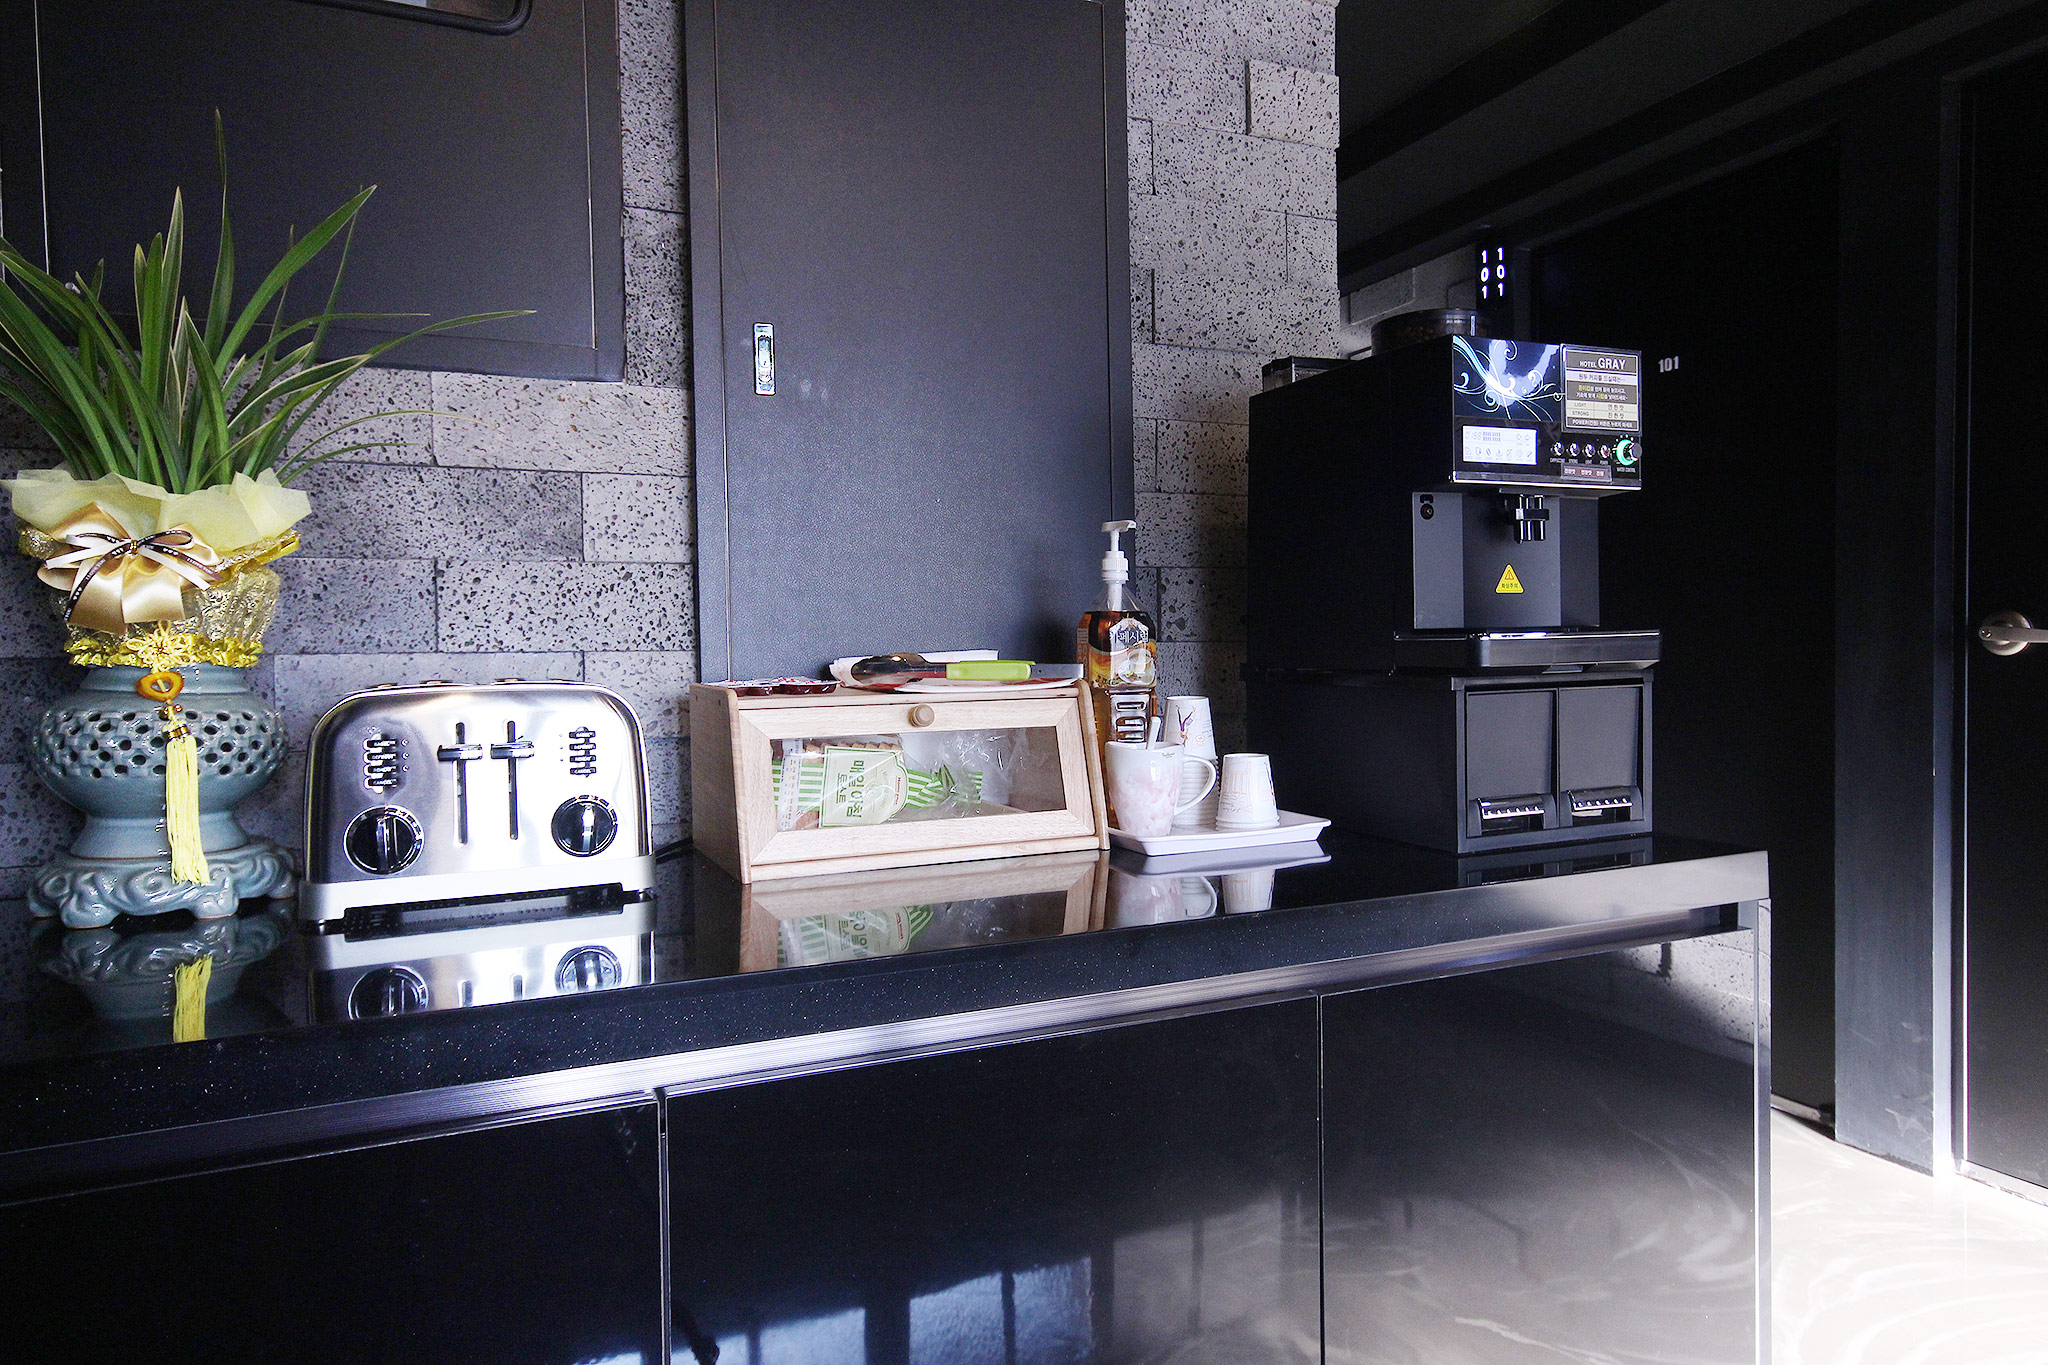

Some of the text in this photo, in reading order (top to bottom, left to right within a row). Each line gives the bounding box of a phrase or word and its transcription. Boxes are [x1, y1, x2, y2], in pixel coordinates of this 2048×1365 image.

[1579, 357, 1626, 370] HOTEL GRAY
[1658, 355, 1680, 373] 101
[835, 772, 848, 804] 토스트
